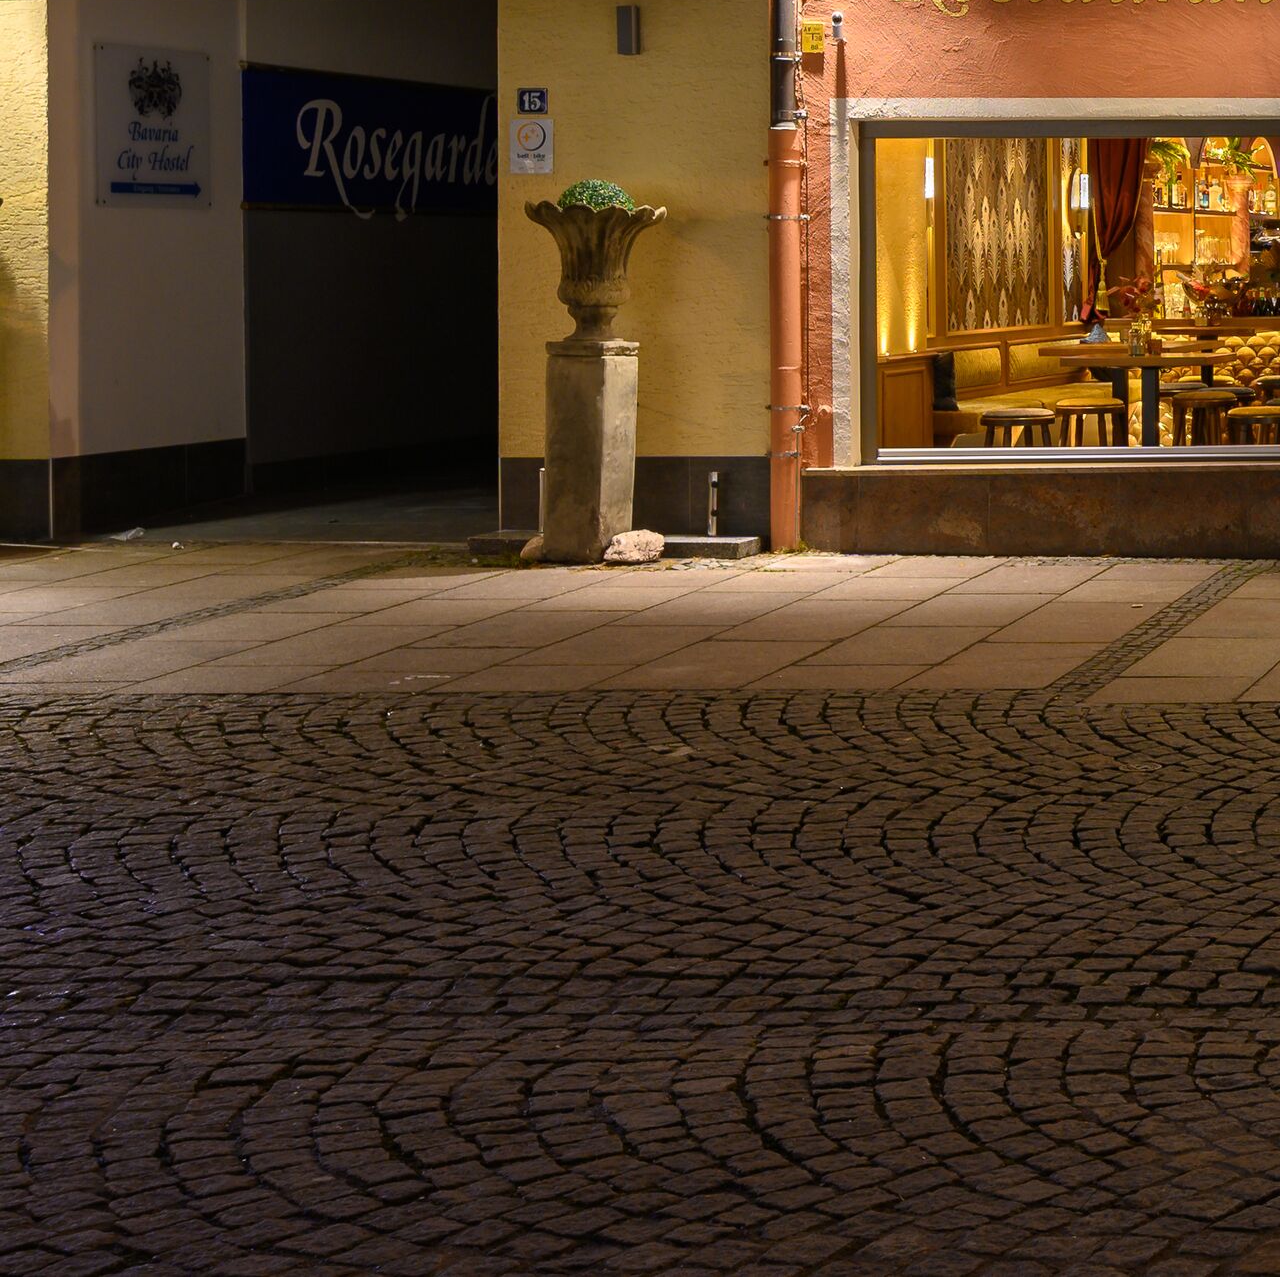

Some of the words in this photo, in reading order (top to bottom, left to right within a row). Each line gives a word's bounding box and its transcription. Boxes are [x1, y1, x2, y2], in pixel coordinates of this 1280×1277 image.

[523, 92, 541, 111] 15
[128, 121, 179, 142] Bavaria
[117, 148, 143, 181] City
[148, 144, 194, 171] Hostel
